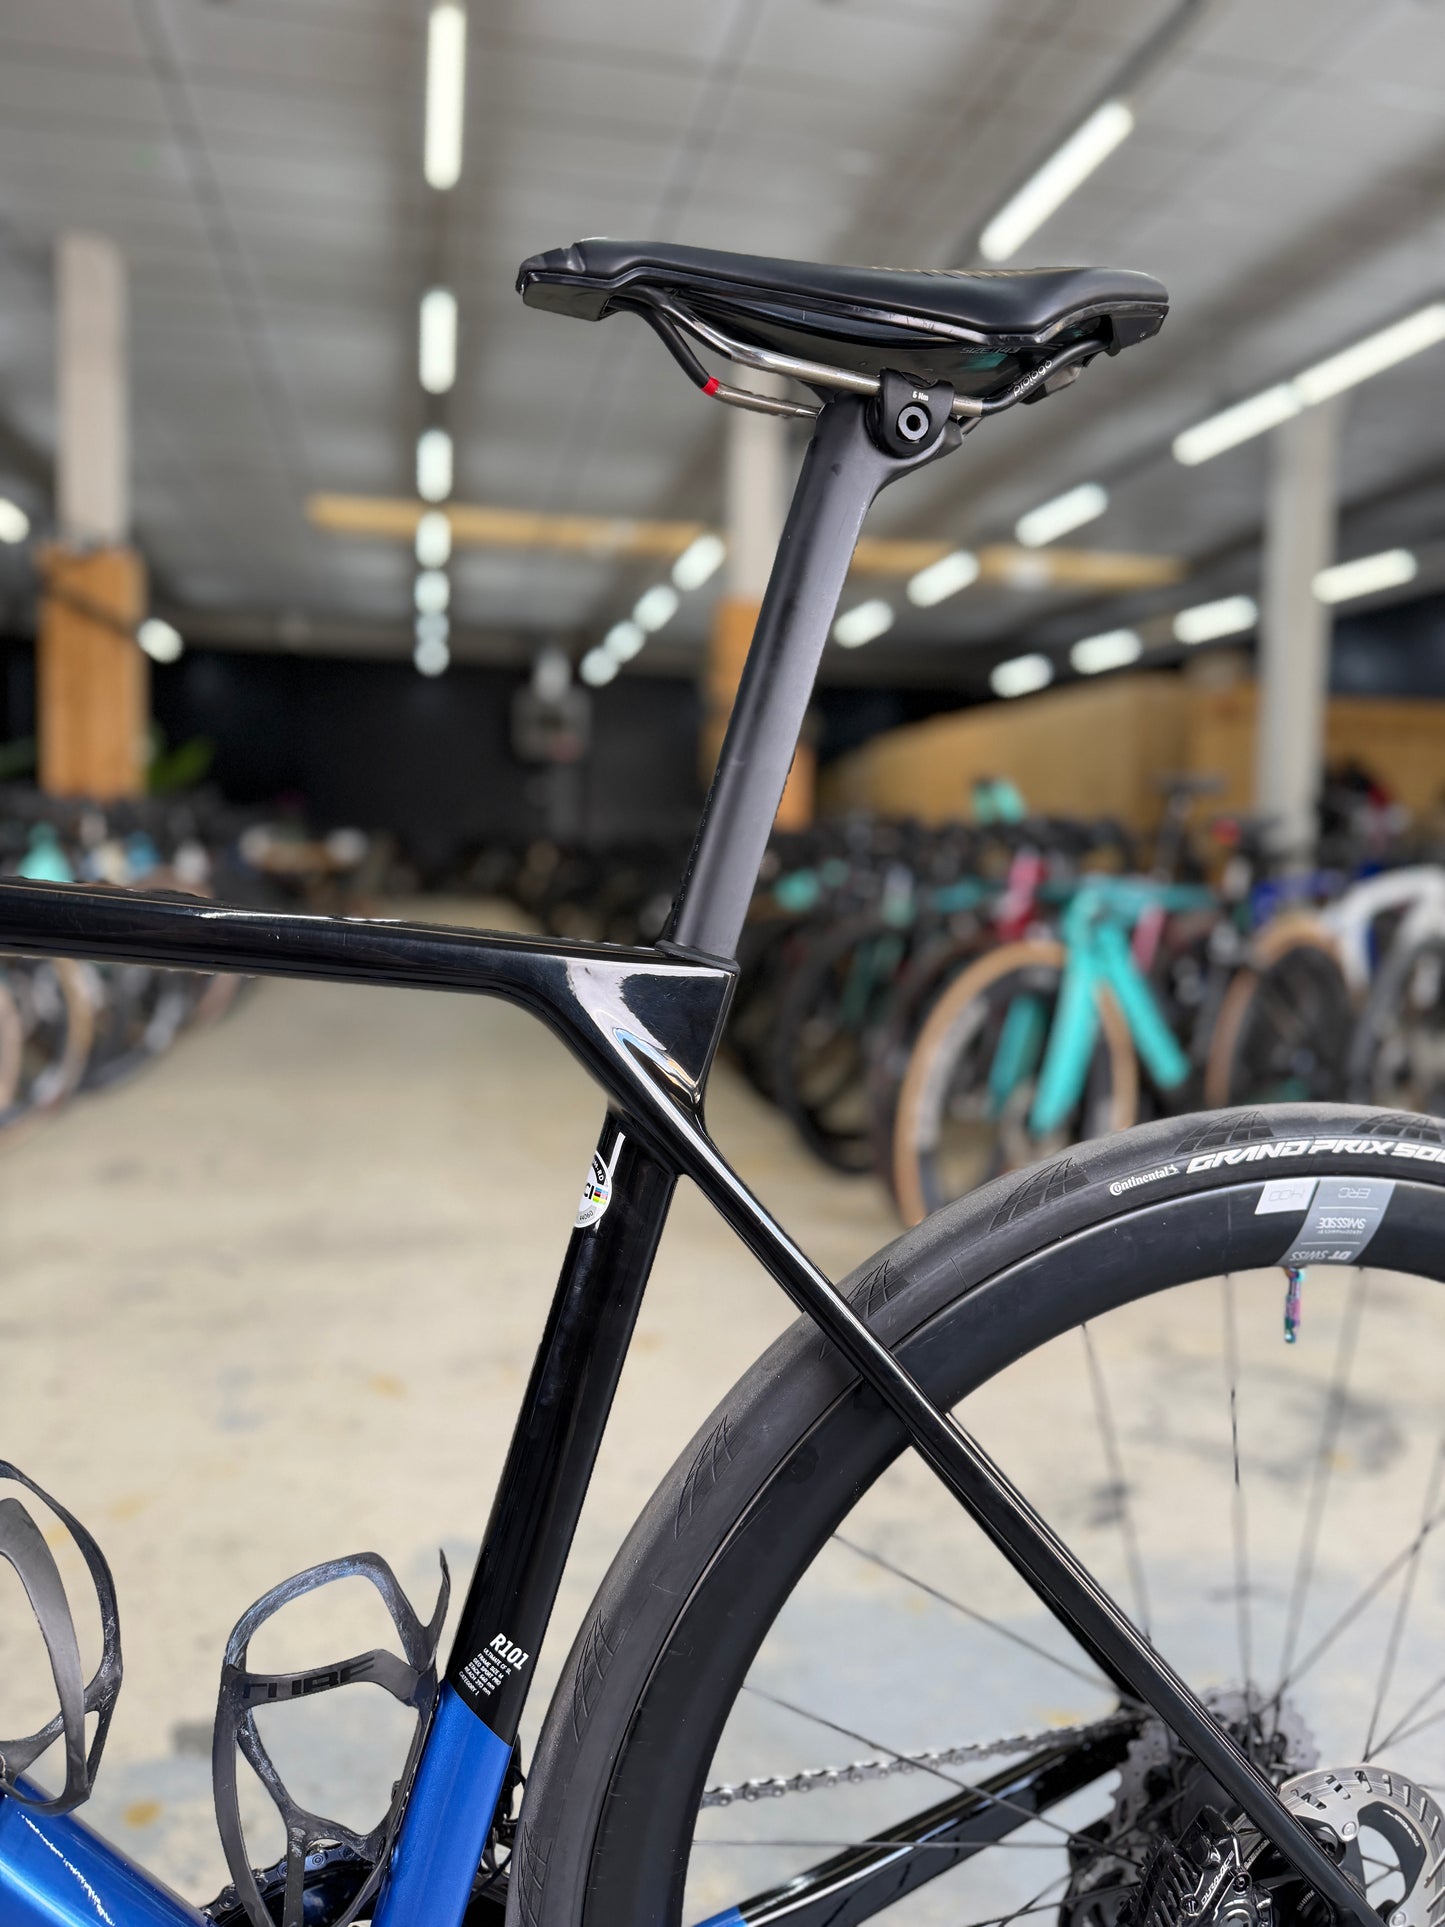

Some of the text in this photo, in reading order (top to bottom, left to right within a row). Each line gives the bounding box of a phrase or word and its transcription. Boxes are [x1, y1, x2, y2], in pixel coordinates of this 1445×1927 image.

[1013, 359, 1053, 398] prologo
[1109, 1165, 1171, 1196] Continental
[1185, 1140, 1311, 1174] GRAND
[1308, 1139, 1395, 1156] PRIX
[1337, 1187, 1372, 1199] ERC
[1288, 1250, 1353, 1262] DT SWISS
[483, 1647, 502, 1667] ULTIMATE
[489, 1632, 530, 1671] R101
[464, 1665, 478, 1681] REACH
[468, 1661, 481, 1677] STACK
[472, 1657, 482, 1668] GEO
[480, 1665, 495, 1679] SPORT
[477, 1652, 492, 1668] FRAME
[489, 1665, 500, 1676] SIZE
[458, 1670, 477, 1692] CATEGORY
